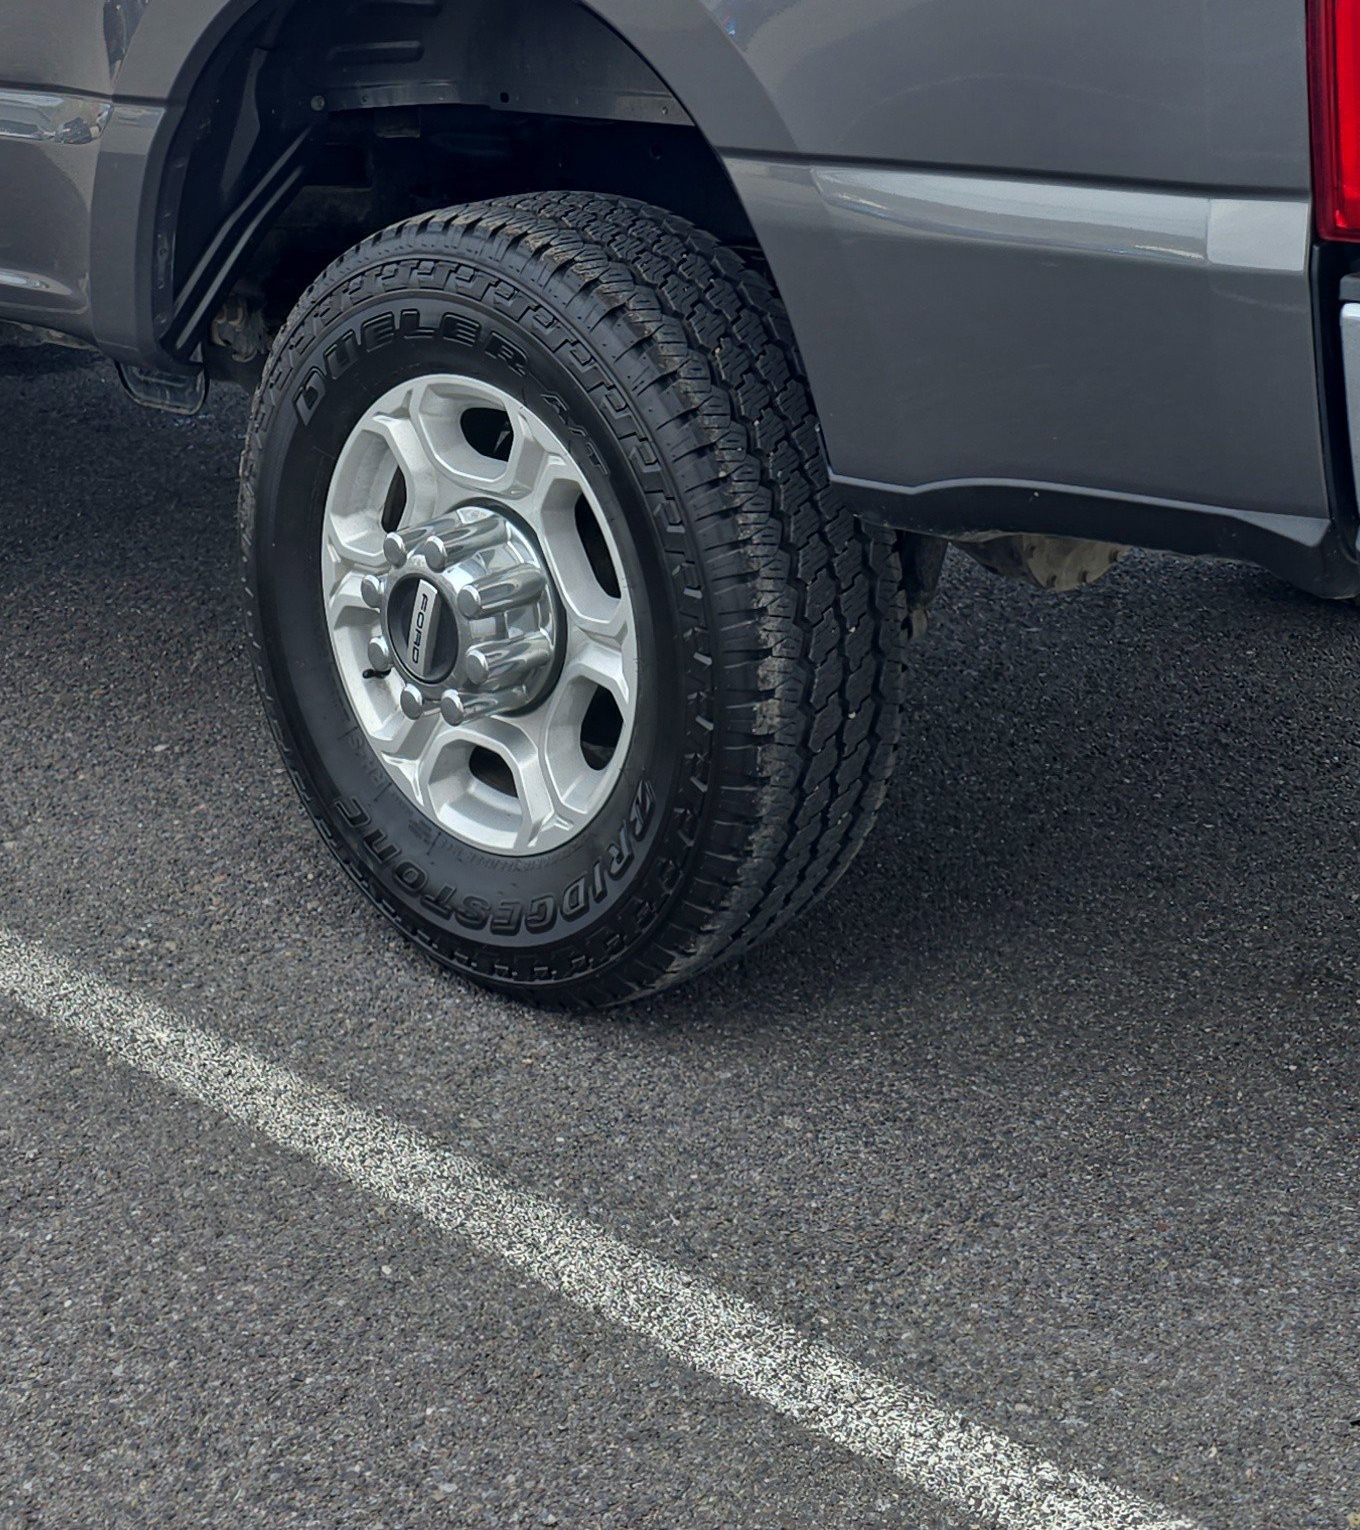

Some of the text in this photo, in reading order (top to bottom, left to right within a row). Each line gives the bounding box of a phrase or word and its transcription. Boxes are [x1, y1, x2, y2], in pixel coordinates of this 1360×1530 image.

[293, 308, 529, 426] DUELER
[412, 593, 429, 664] FORD
[334, 775, 656, 936] BRIDGESTONE
